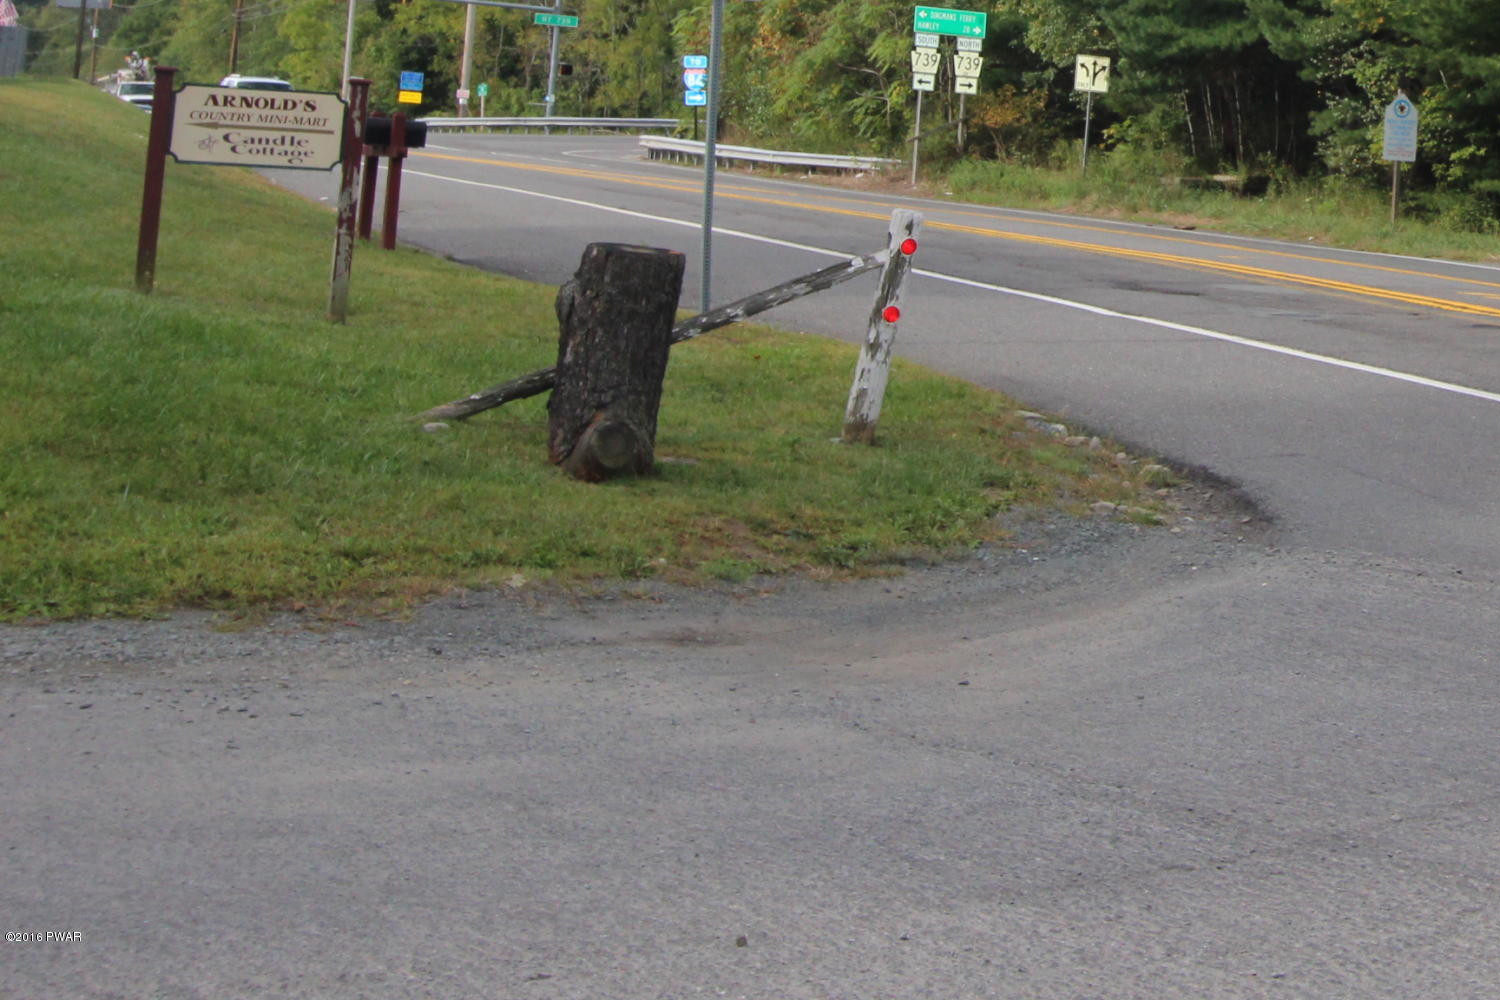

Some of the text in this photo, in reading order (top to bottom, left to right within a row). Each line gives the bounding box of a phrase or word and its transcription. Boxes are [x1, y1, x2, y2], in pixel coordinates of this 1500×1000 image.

[917, 35, 938, 45] SOUTH
[959, 39, 981, 49] NORTH
[915, 52, 938, 67] 739
[957, 56, 981, 71] 739
[204, 94, 317, 112] ARNOLD'S
[189, 110, 329, 127] COUNTRY MINI-MART
[222, 132, 310, 148] Candle
[230, 144, 315, 165] Cottage
